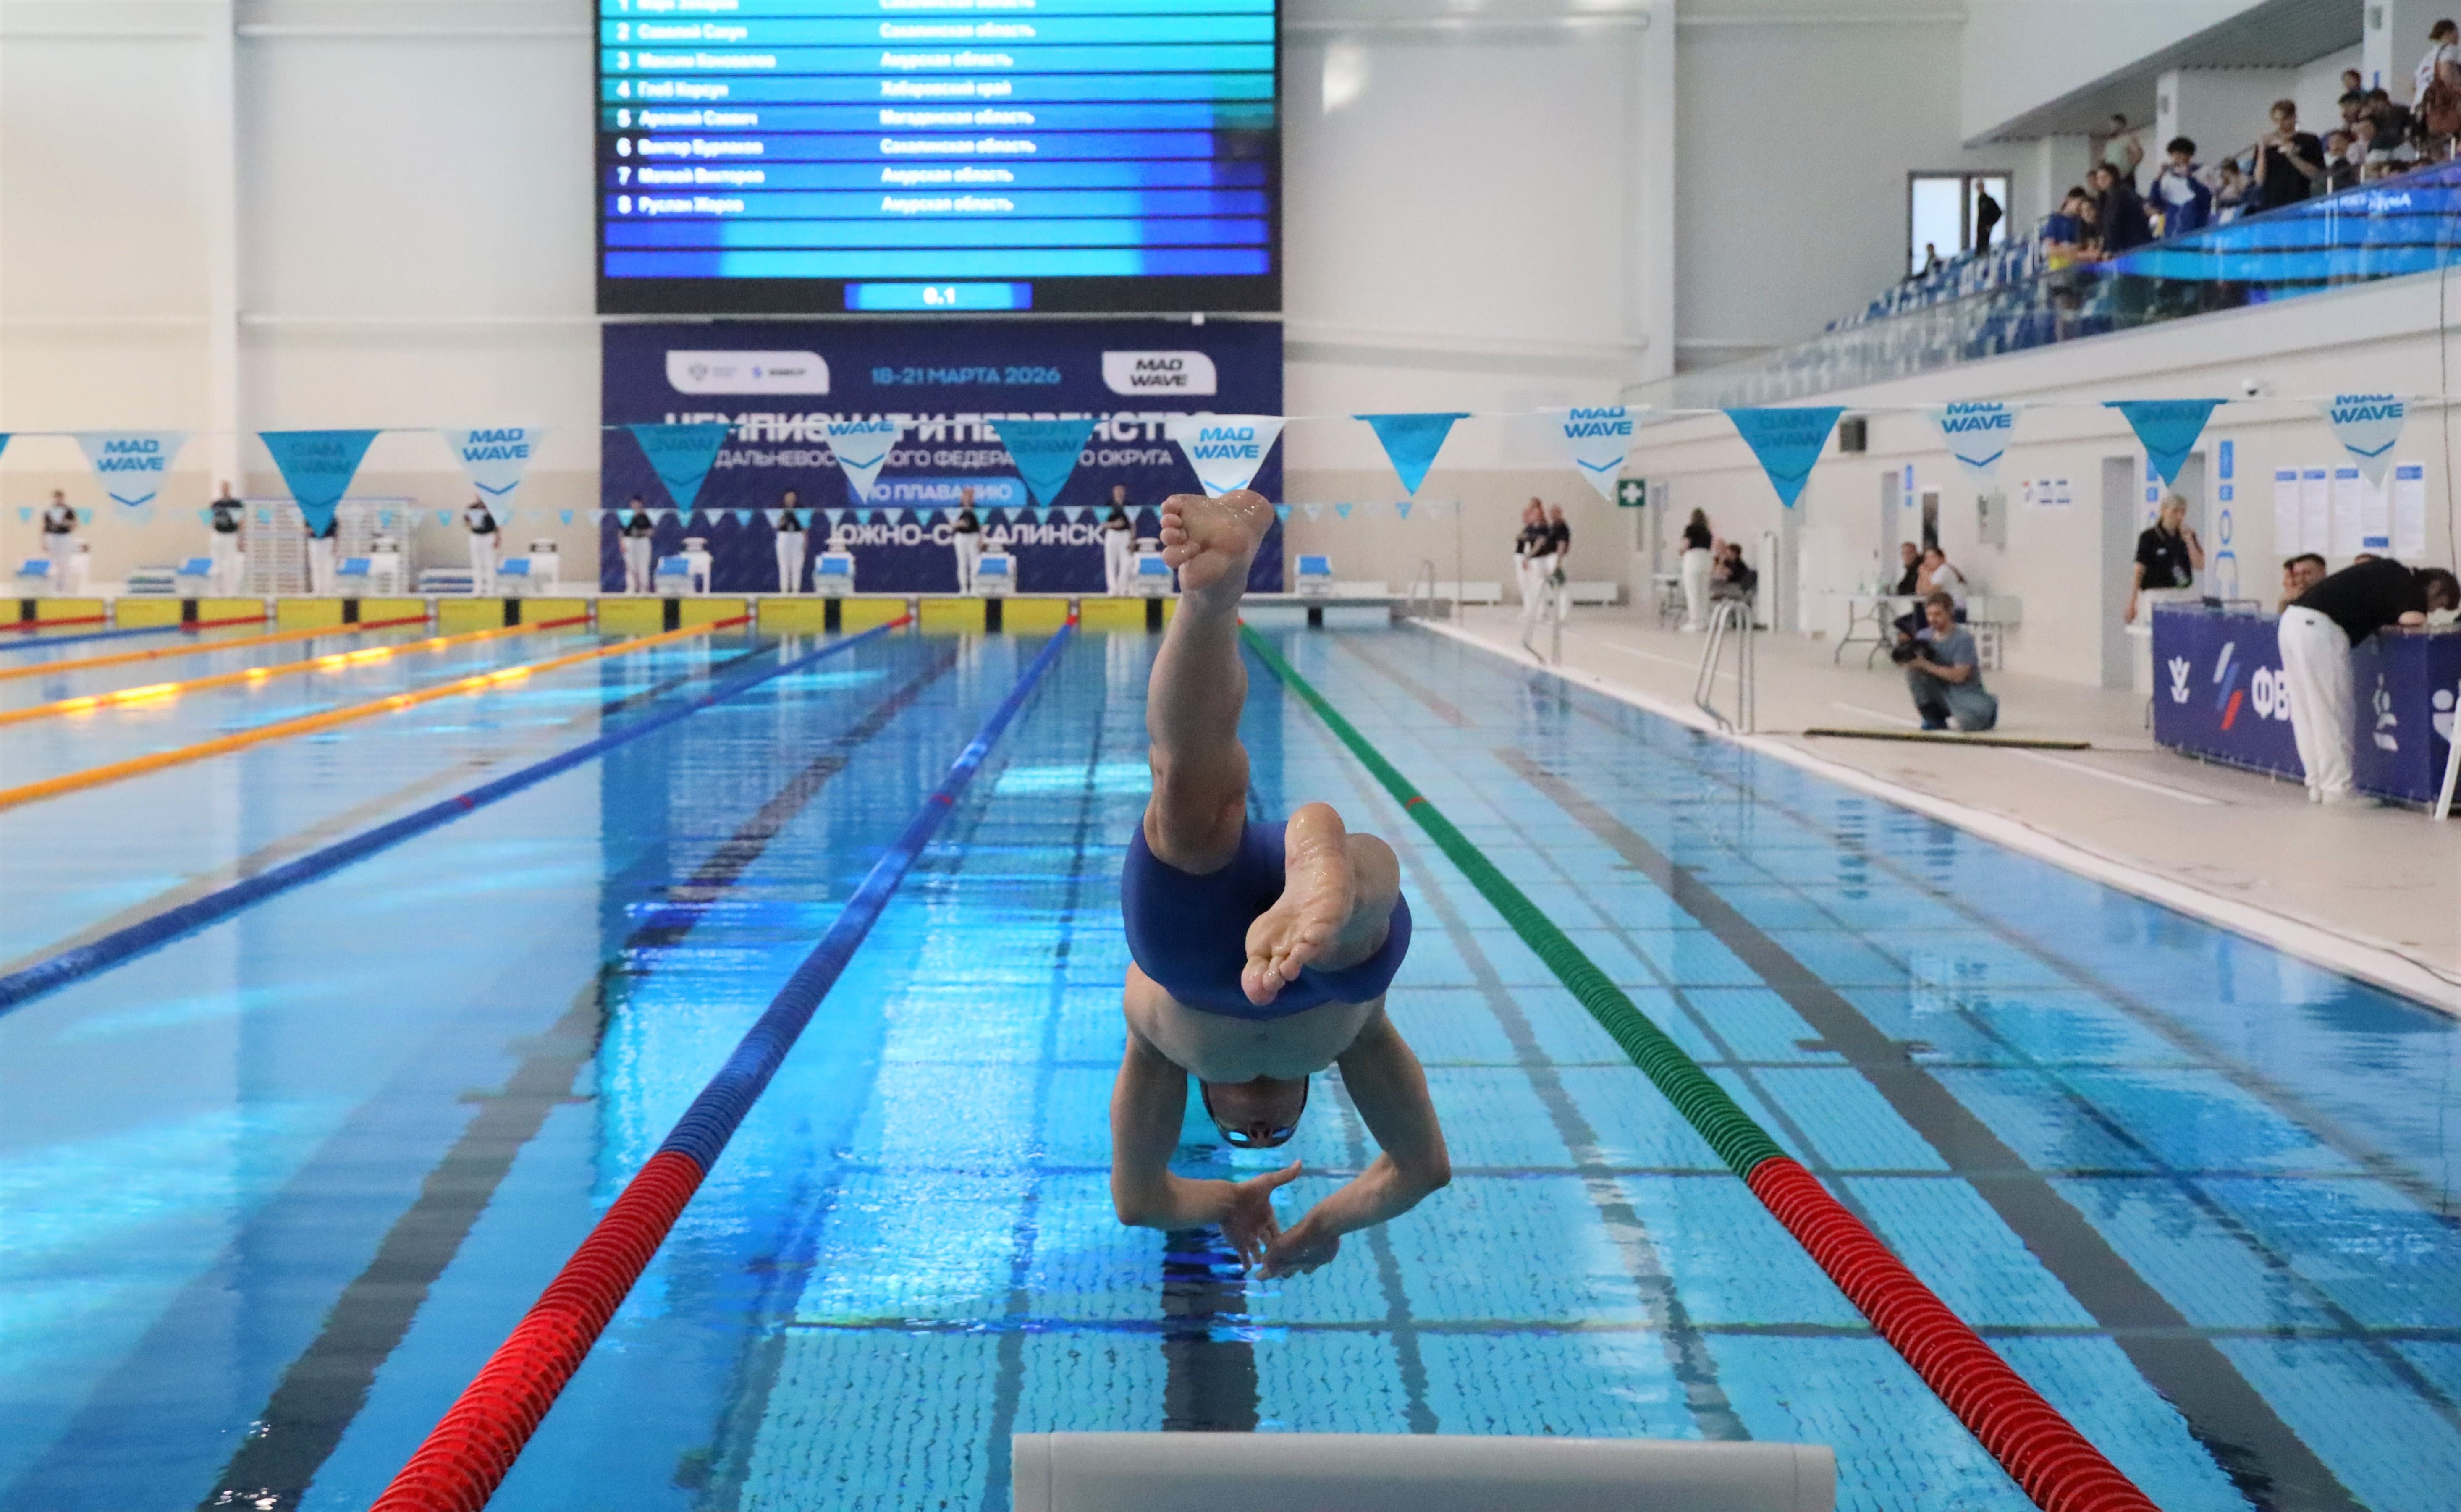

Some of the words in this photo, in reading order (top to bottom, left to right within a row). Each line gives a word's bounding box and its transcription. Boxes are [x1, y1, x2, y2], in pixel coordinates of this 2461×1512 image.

[618, 23, 630, 41] 2
[618, 52, 630, 69] 3
[617, 81, 631, 97] 4
[618, 109, 631, 127] 5
[617, 138, 631, 156] 6
[619, 166, 632, 185] 7
[1135, 359, 1183, 371] MAD
[872, 367, 924, 385] 18-21
[927, 367, 1001, 385] МАРТА
[1004, 367, 1061, 385] 2026
[1130, 374, 1187, 387] WAVE
[1570, 406, 1625, 420] MAD
[2330, 403, 2403, 424] WAVE
[827, 421, 894, 436] WAVE
[1564, 421, 1633, 438] WAVE
[1941, 414, 2012, 433] WAVE
[469, 428, 524, 443] MAD
[1200, 427, 1255, 442] MAD
[103, 439, 160, 453] MAD
[462, 444, 529, 462] WAVE
[1193, 444, 1260, 460] WAVE
[97, 456, 164, 472] WAVE
[1097, 448, 1174, 467] ОКРУГА
